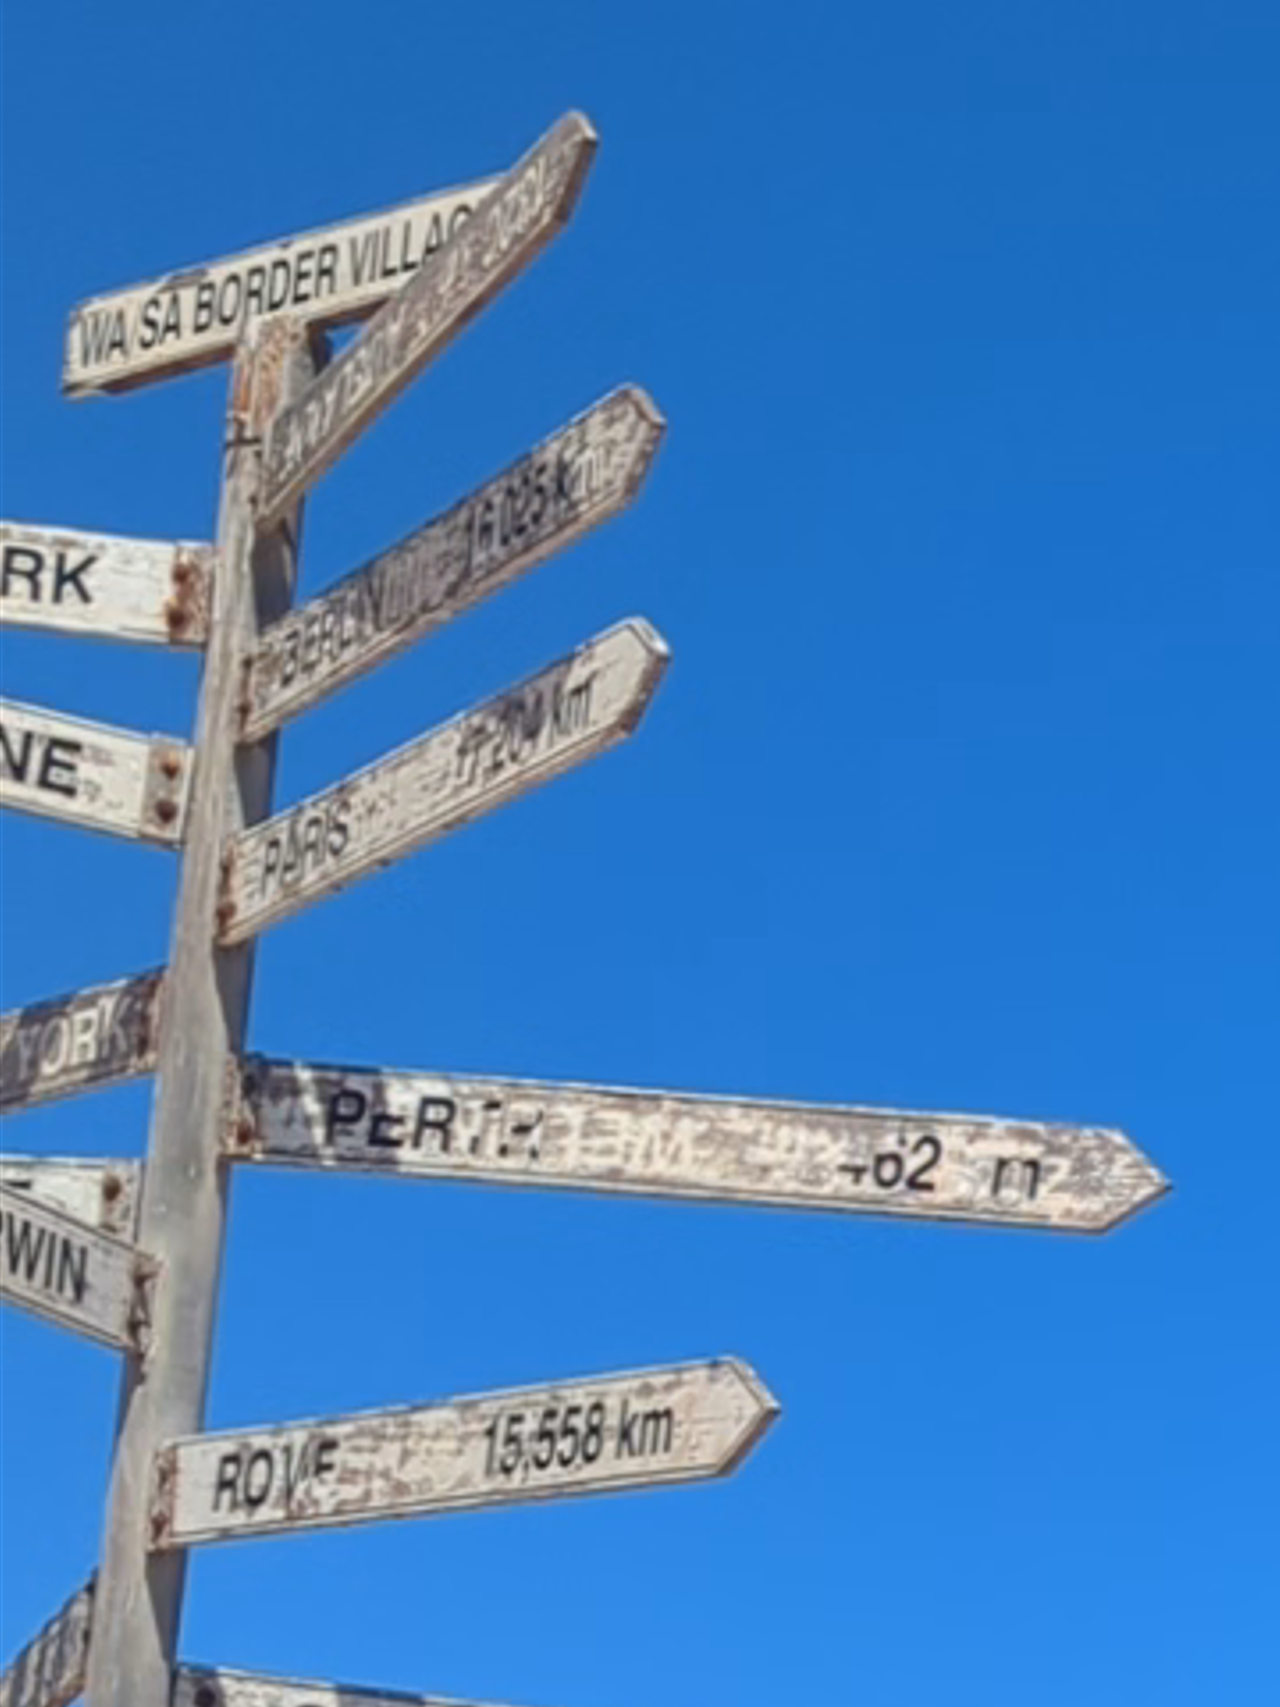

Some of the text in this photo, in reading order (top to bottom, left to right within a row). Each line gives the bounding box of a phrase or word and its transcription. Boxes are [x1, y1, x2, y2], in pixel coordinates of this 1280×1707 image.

[194, 244, 339, 333] BORDER
[0, 1210, 88, 1304] WIN
[482, 1402, 602, 1483] 15,558
[615, 1397, 674, 1460] km
